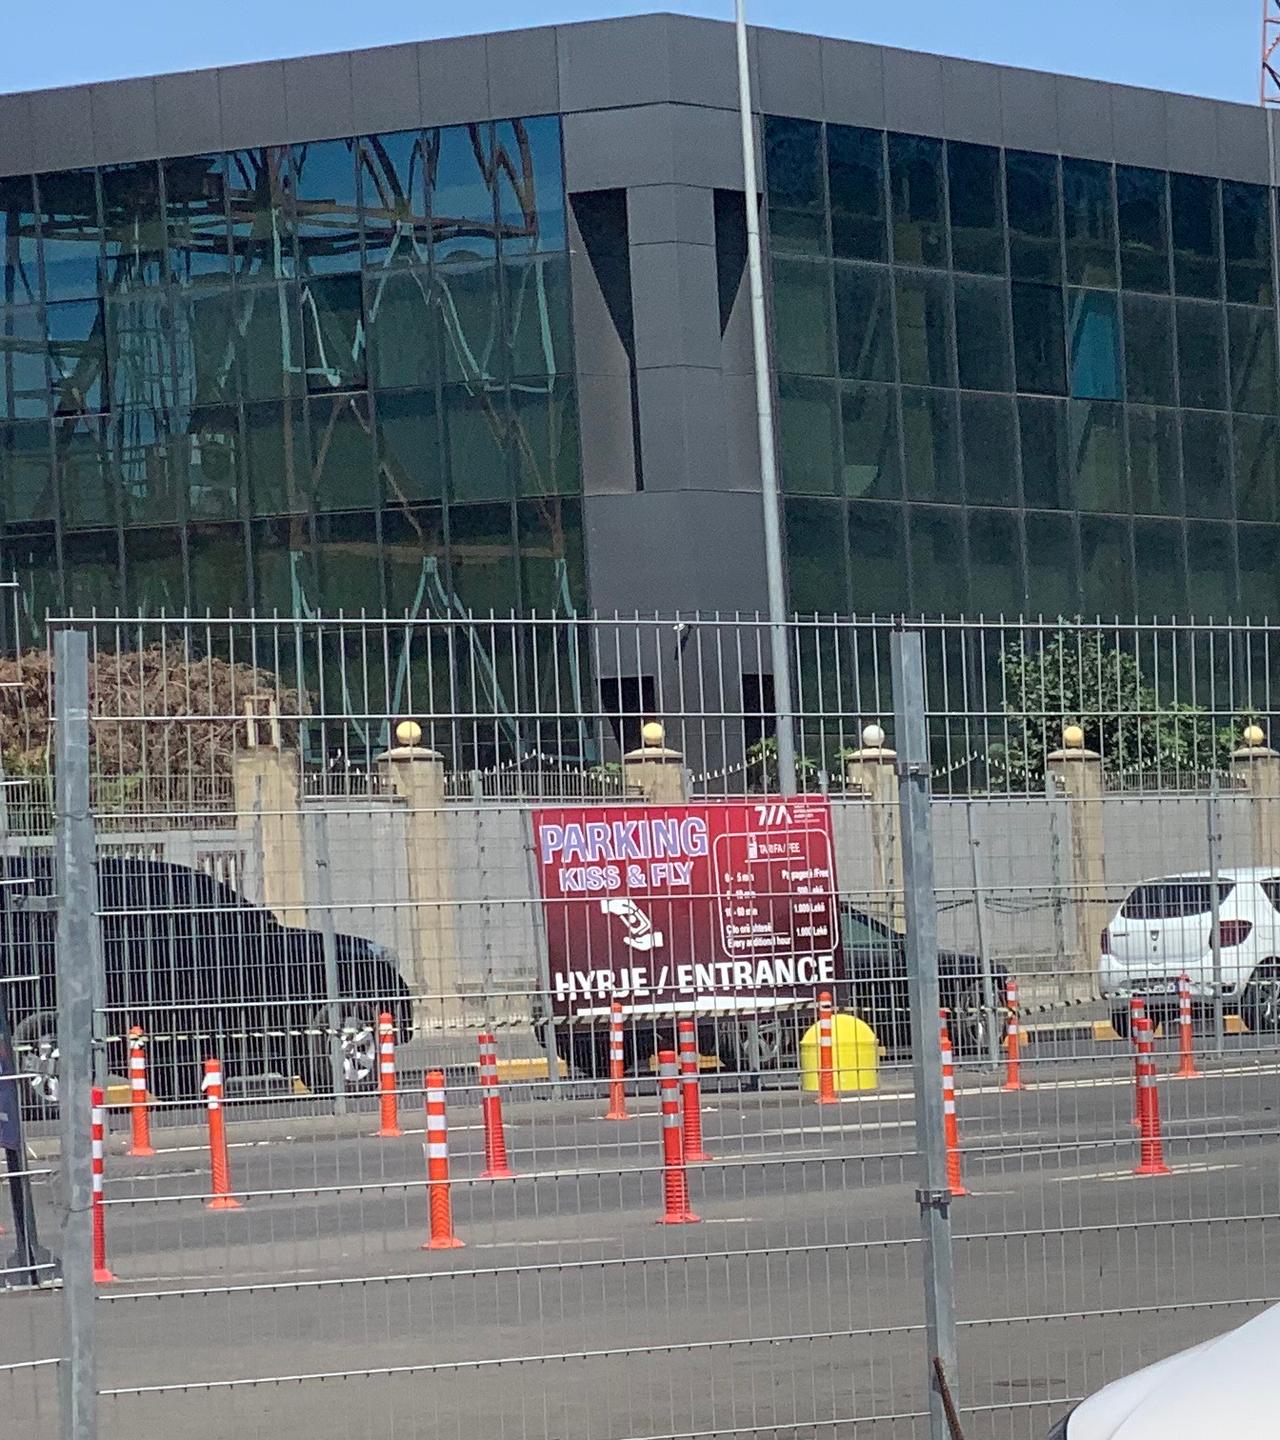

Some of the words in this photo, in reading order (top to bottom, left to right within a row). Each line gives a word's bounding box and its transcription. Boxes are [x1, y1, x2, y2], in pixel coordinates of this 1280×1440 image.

[539, 817, 709, 864] PARKING
[559, 865, 621, 892] KISS
[627, 864, 647, 888] &
[651, 861, 694, 887] FLY
[555, 967, 650, 1001] HYRJE
[676, 956, 834, 994] ENTRANCE
